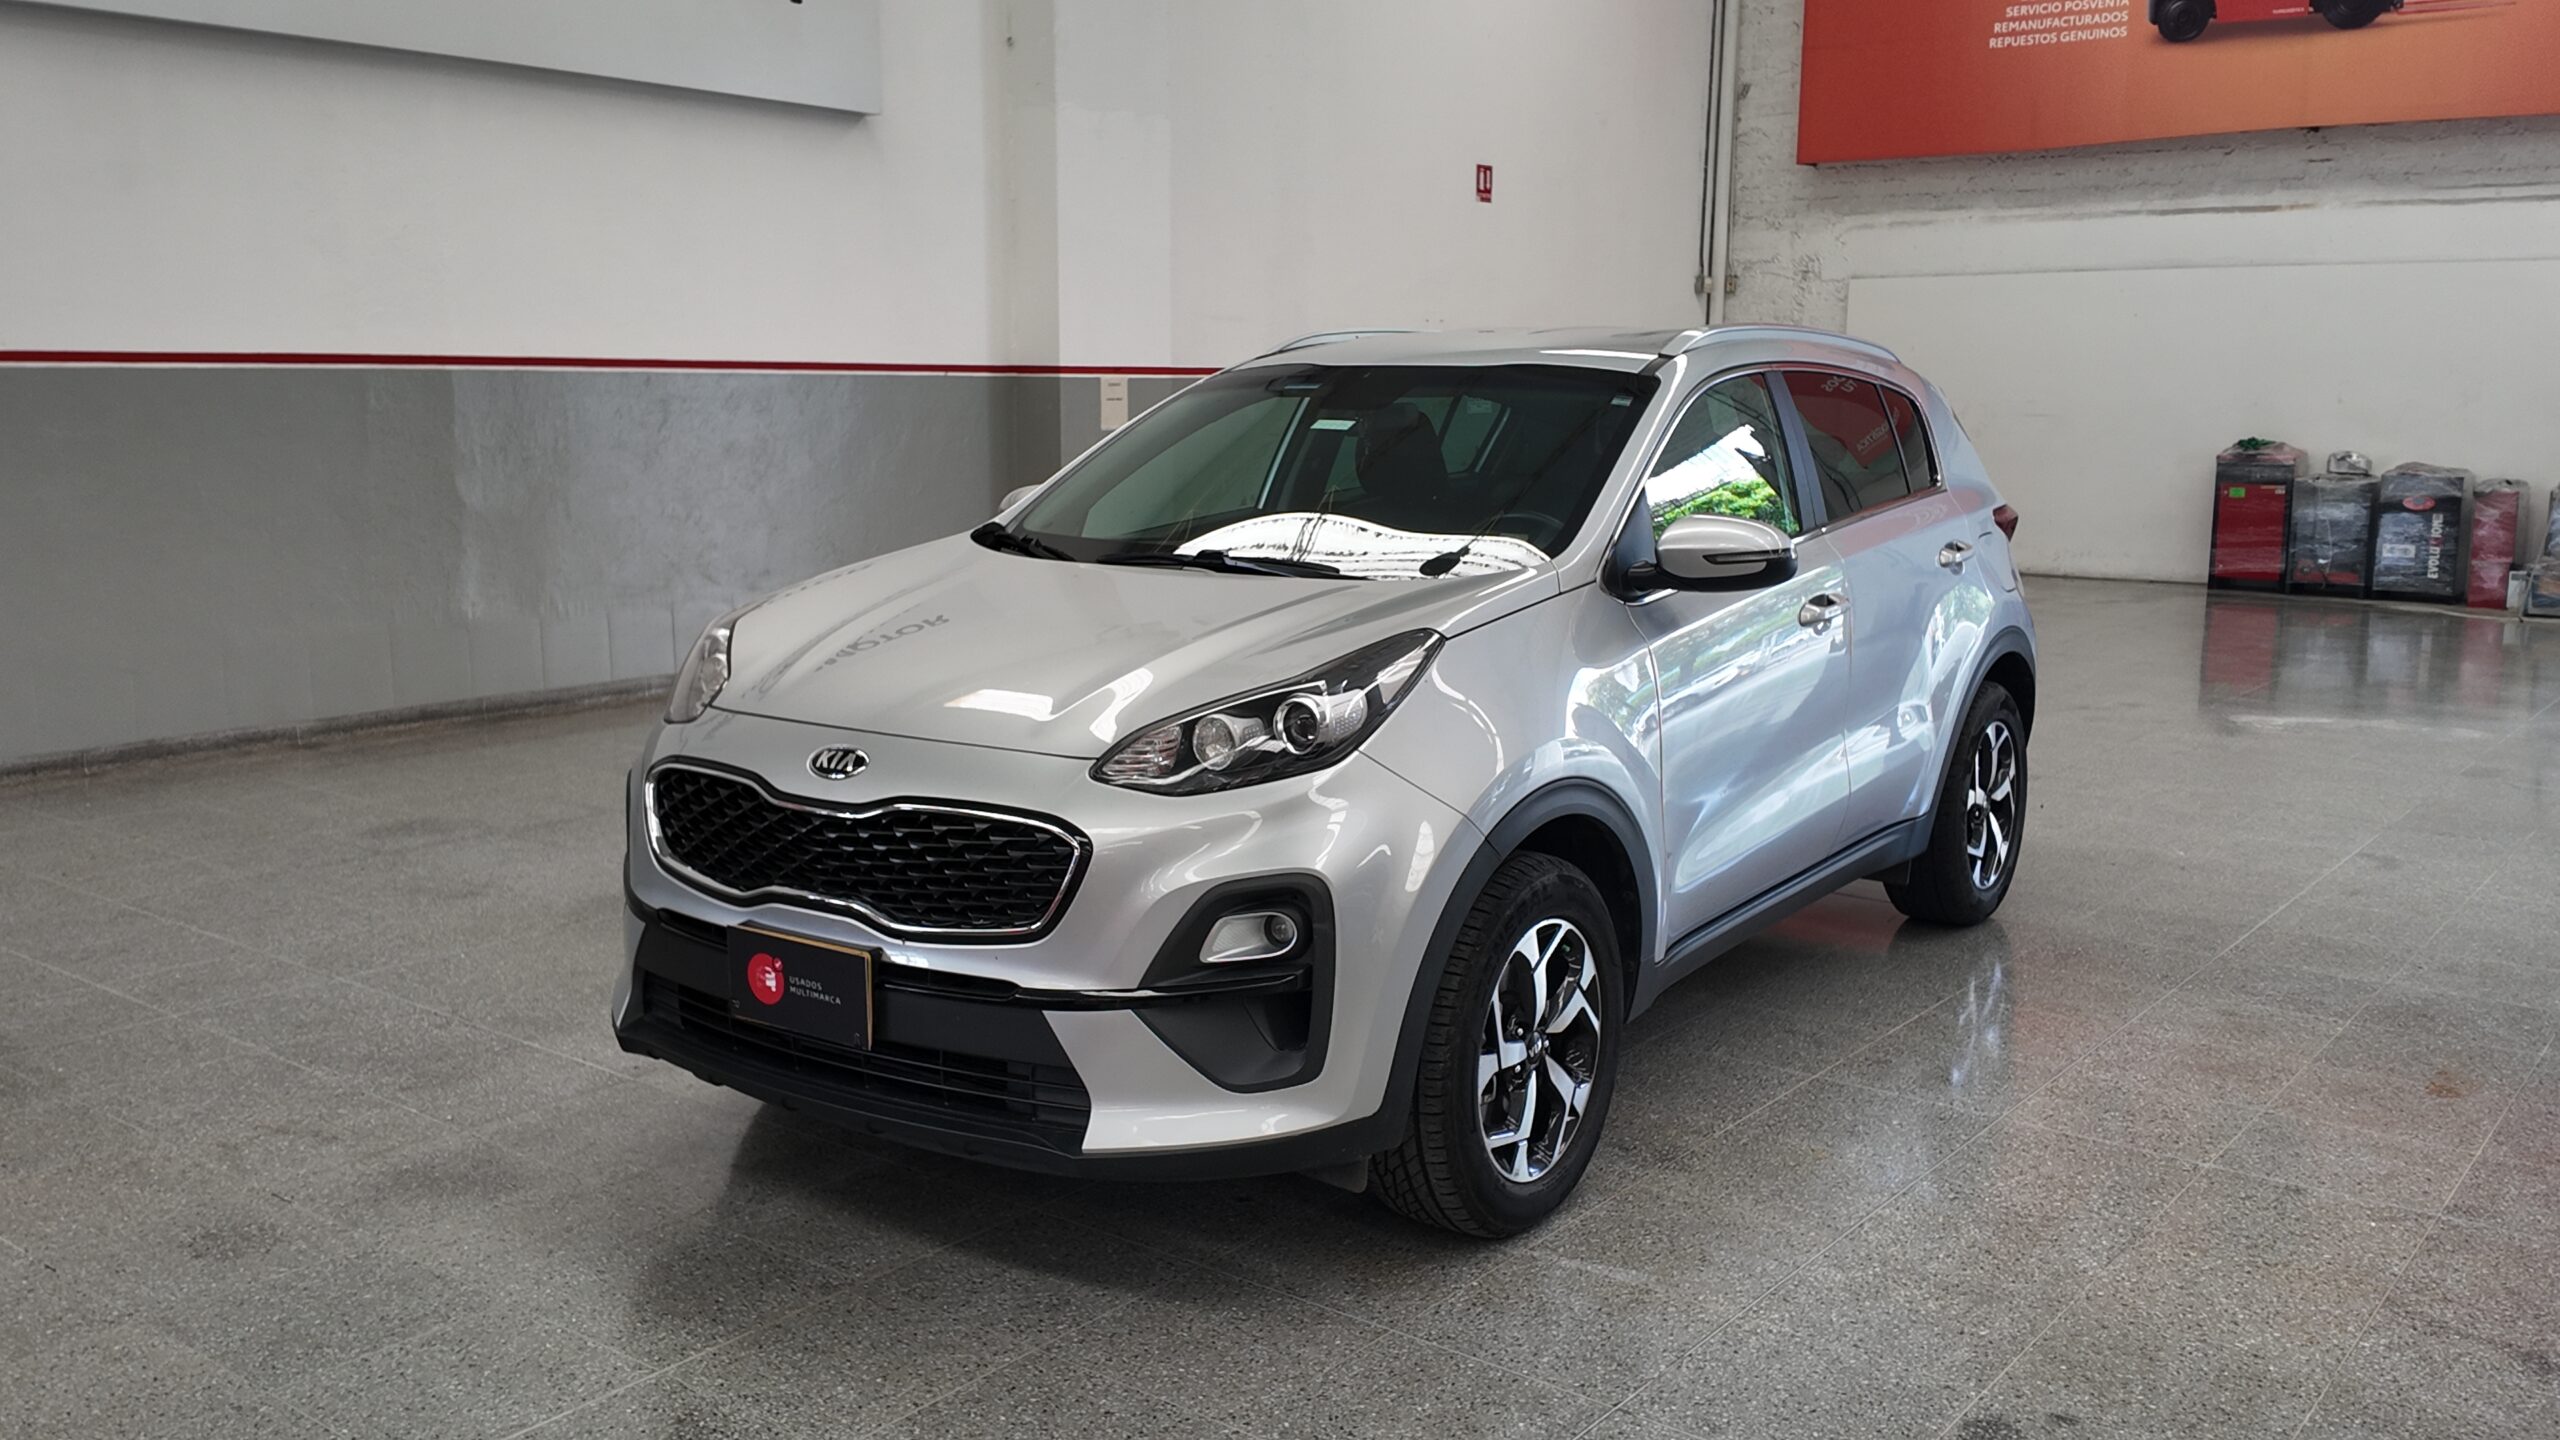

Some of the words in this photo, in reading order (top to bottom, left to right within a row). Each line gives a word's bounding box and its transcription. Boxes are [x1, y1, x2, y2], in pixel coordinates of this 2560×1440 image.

[2006, 3, 2062, 17] SERVICIO
[2064, 0, 2129, 12] POSVENTA
[1993, 11, 2129, 33] REMANUFACTURADOS
[1989, 33, 2057, 48] REPUESTOS
[2060, 27, 2127, 42] GENUINOS
[815, 750, 857, 772] KIA
[789, 976, 822, 991] USADOS
[790, 985, 841, 1005] MULTIMARCA
